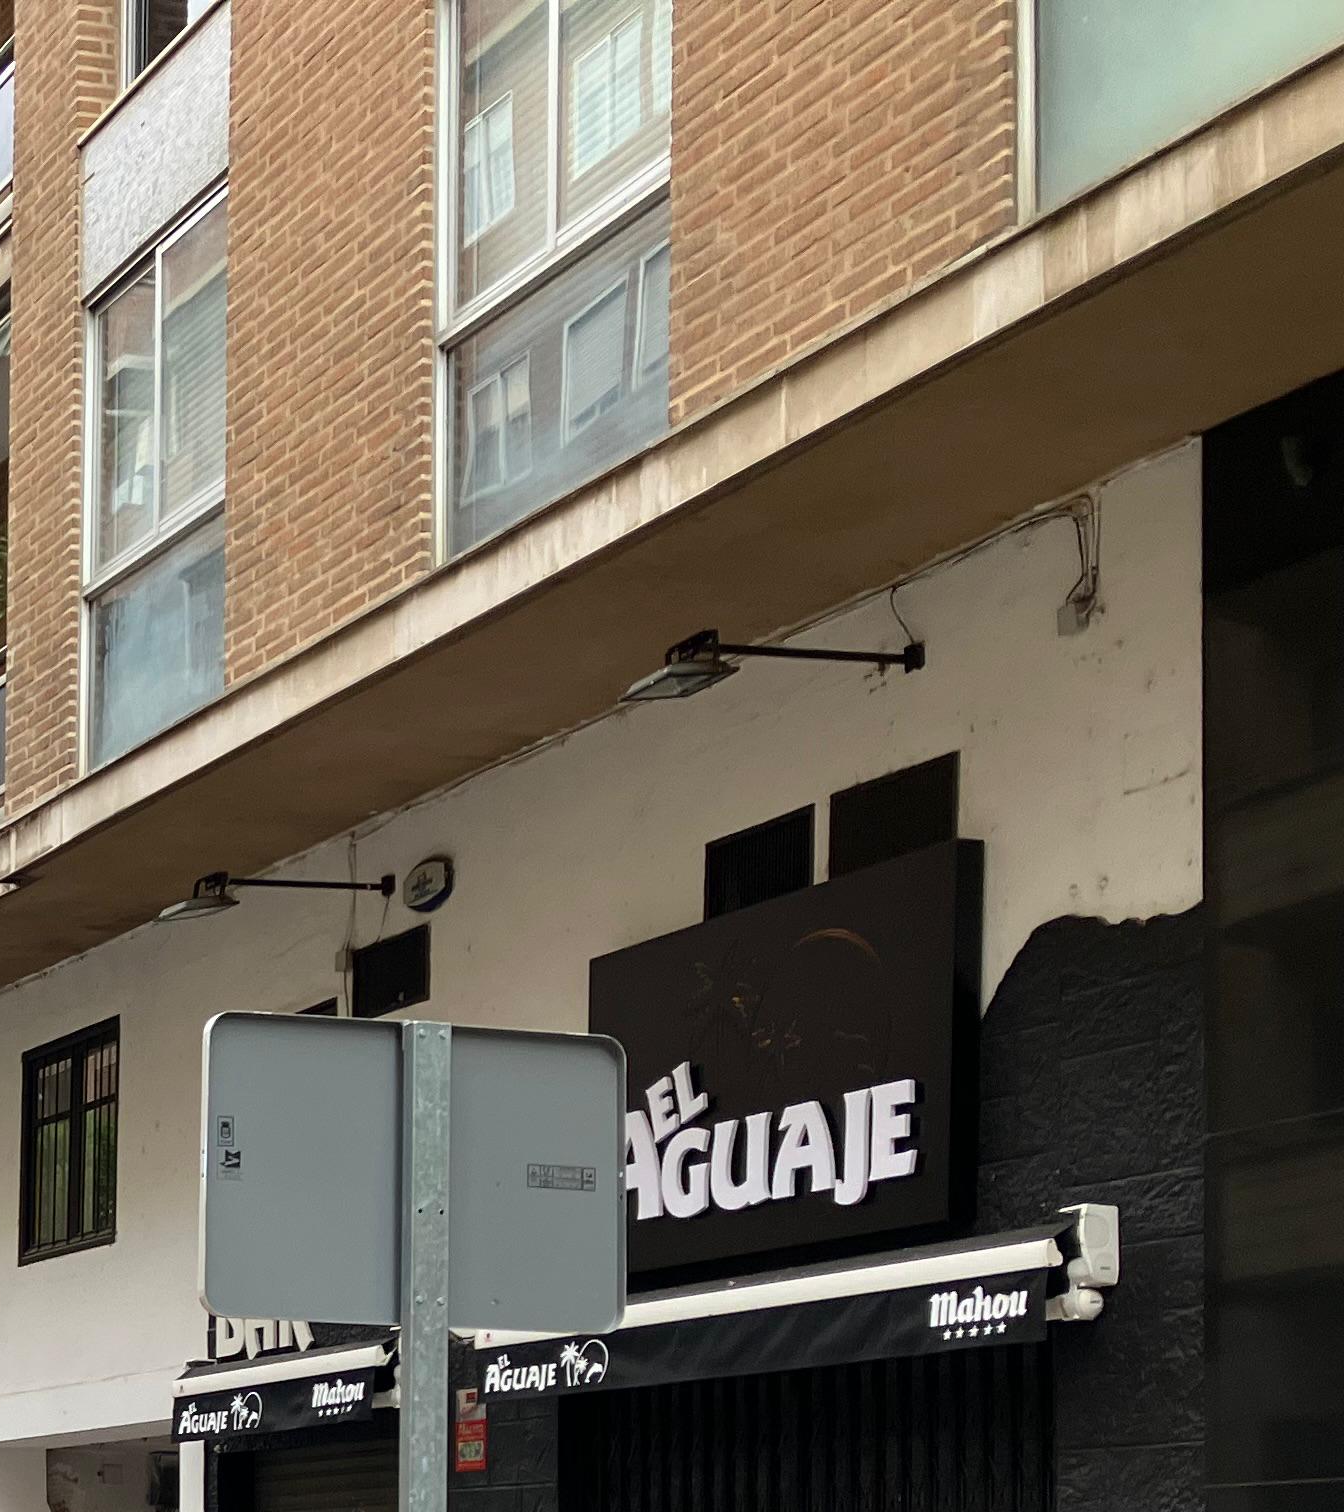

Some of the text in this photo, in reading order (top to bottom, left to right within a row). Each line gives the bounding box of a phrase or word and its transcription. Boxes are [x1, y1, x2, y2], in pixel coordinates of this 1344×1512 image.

[645, 1061, 709, 1144] EL
[626, 1078, 918, 1221] AGUAJE
[929, 1285, 1029, 1328] Mahou
[496, 1353, 511, 1370] EL
[311, 1378, 365, 1408] Mahou
[484, 1362, 558, 1394] AGUAJE
[177, 1409, 229, 1435] AGUAJE
